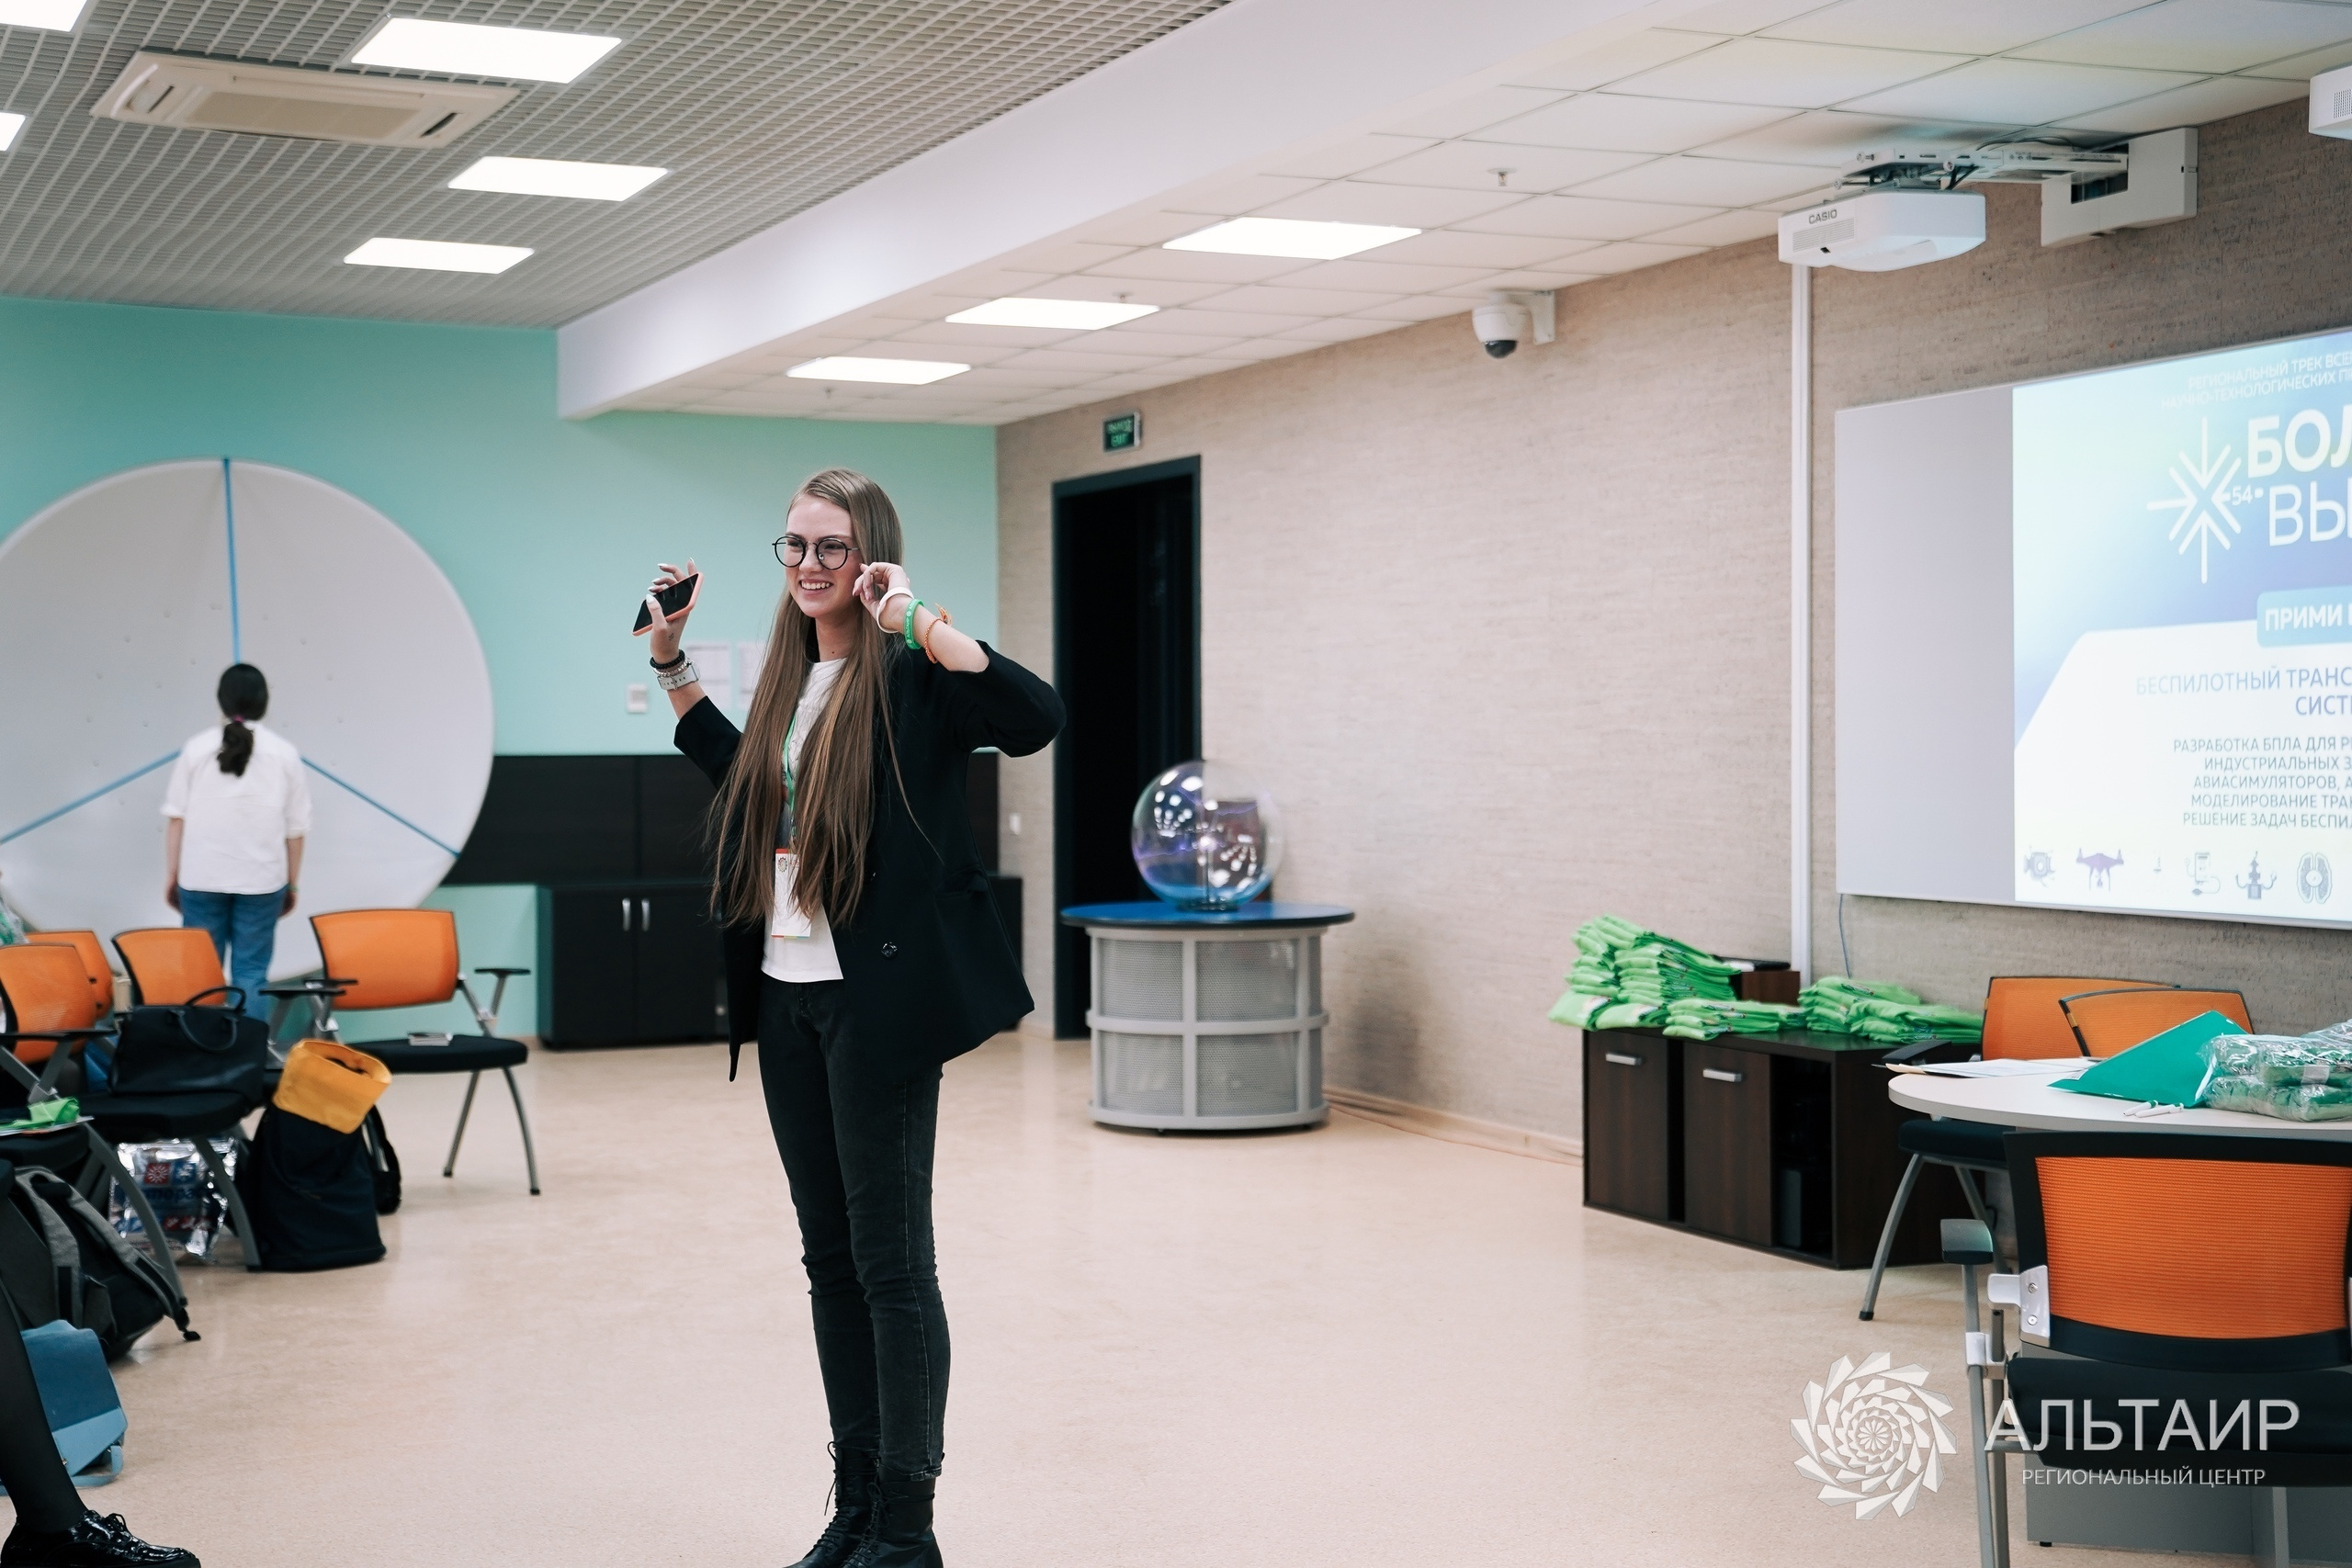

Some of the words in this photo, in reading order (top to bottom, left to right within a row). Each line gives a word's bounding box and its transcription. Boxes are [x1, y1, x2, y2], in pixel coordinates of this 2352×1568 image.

[1808, 209, 1838, 224] CASIO
[2188, 358, 2289, 390] РЕГИОНАЛЬНЫЙ
[2290, 355, 2323, 375] ТРЕК
[2161, 370, 2335, 410] НАУЧНО-ТЕХНОЛОГИЧЕСКИХ
[2265, 604, 2342, 631] ПРИМИ
[2136, 665, 2280, 695] БЕСПИЛОТНЫЙ
[2286, 666, 2352, 688] ТРАНС
[2295, 694, 2352, 716] СИСТ
[2174, 738, 2259, 752] РАЗРАБОТКА
[2263, 738, 2301, 751] БПЛА
[2305, 737, 2336, 753] ДЛЯ
[2204, 756, 2339, 772] ИНДУСТРИАЛЬНЫХ
[2194, 775, 2340, 791] АВИАСИМУЛЯТОРОВ,
[2191, 795, 2317, 809] МОДЕЛИРОВАНИЕ
[2183, 812, 2246, 827] РЕШЕНИЕ
[2250, 813, 2297, 830] ЗАДАЧ
